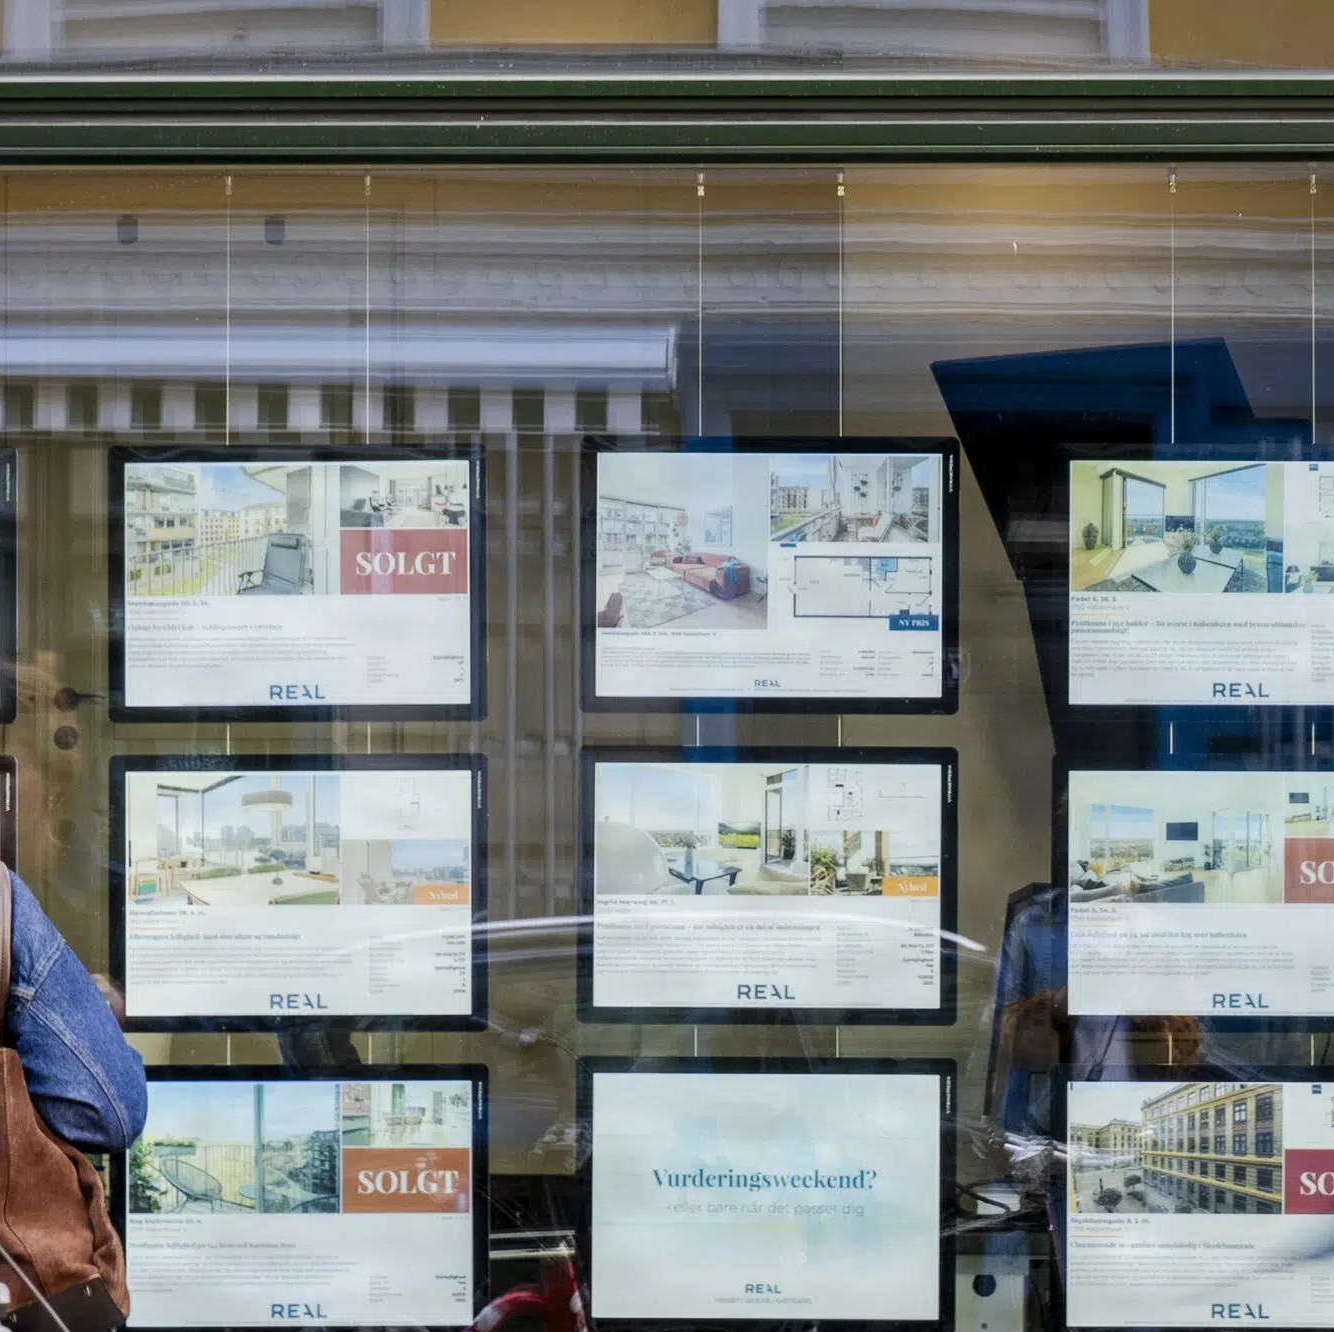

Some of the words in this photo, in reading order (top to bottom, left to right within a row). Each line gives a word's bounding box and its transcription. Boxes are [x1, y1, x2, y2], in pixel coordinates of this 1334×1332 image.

[355, 551, 457, 577] SOLGT
[898, 619, 911, 627] NY
[911, 619, 931, 627] PRIS
[754, 679, 782, 688] REAL
[1212, 682, 1270, 698] REAL
[269, 684, 326, 700] REAL
[737, 984, 796, 1000] REAL
[270, 993, 329, 1009] REAL
[1212, 993, 1270, 1009] REAL
[357, 1170, 460, 1195] SOLGT
[652, 1168, 878, 1192] Vurderingsweekend?
[673, 1202, 702, 1213] eller
[706, 1202, 738, 1214] bare
[740, 1202, 763, 1214] når
[767, 1202, 790, 1214] det
[794, 1205, 837, 1216] passer
[842, 1203, 865, 1217] dig
[745, 1283, 783, 1294] REAL
[271, 1303, 328, 1319] REAL
[1210, 1303, 1271, 1319] REAL
